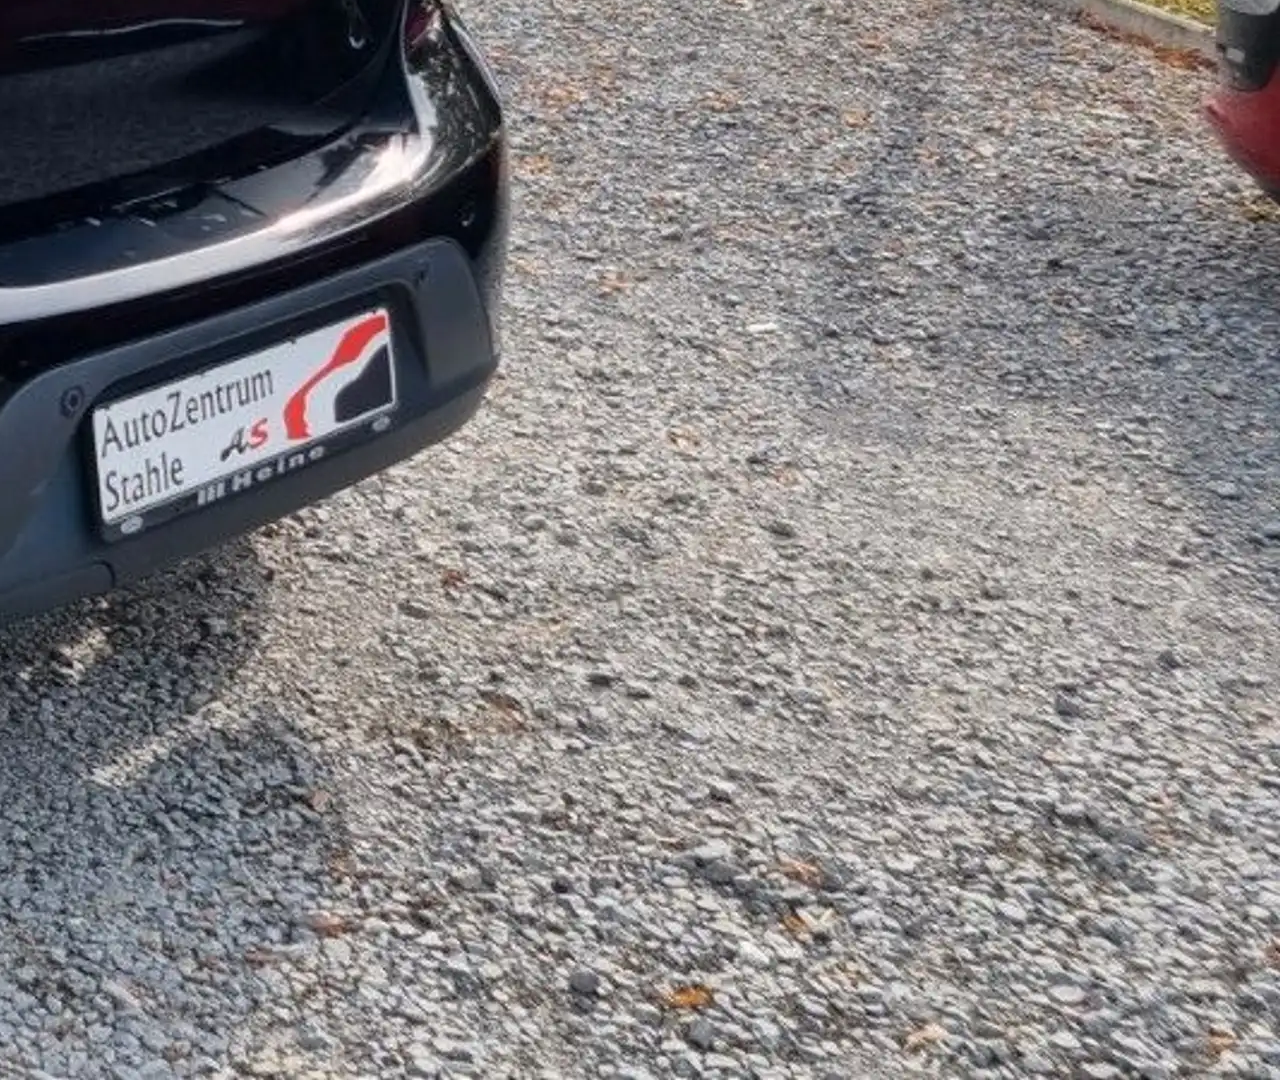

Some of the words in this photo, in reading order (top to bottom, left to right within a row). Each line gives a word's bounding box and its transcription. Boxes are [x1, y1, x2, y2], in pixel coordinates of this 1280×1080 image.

[101, 369, 274, 459] AutoZentrum
[105, 451, 184, 513] Stahle
[220, 417, 269, 462] AS
